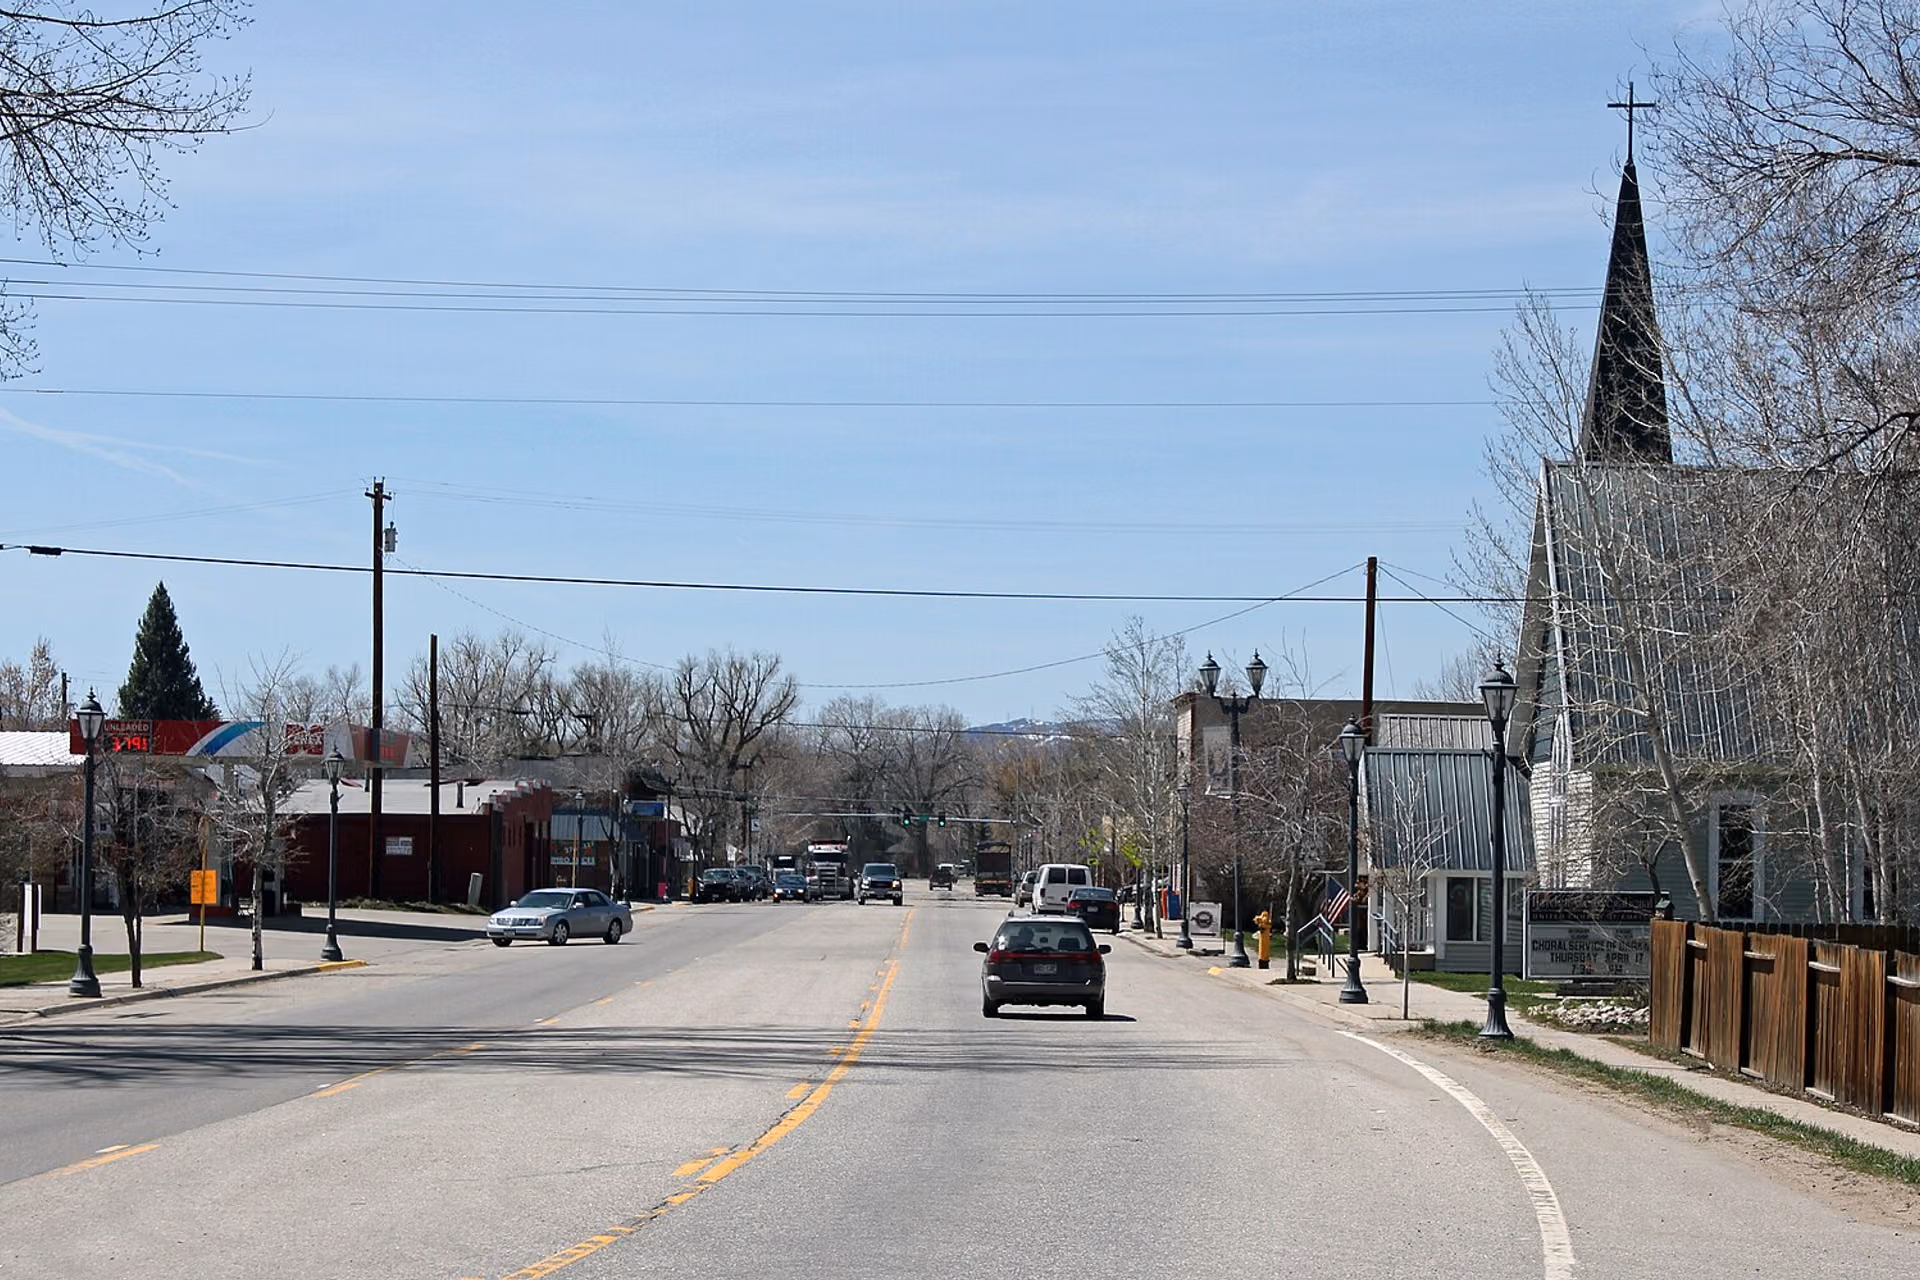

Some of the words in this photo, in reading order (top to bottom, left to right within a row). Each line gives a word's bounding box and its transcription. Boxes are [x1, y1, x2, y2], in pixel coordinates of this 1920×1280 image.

[1532, 940, 1566, 951] CHORAL
[1568, 940, 1604, 951] SERVICE
[1550, 952, 1598, 962] THURSDAY
[1605, 952, 1629, 962] APRIL
[1635, 952, 1644, 962] 17
